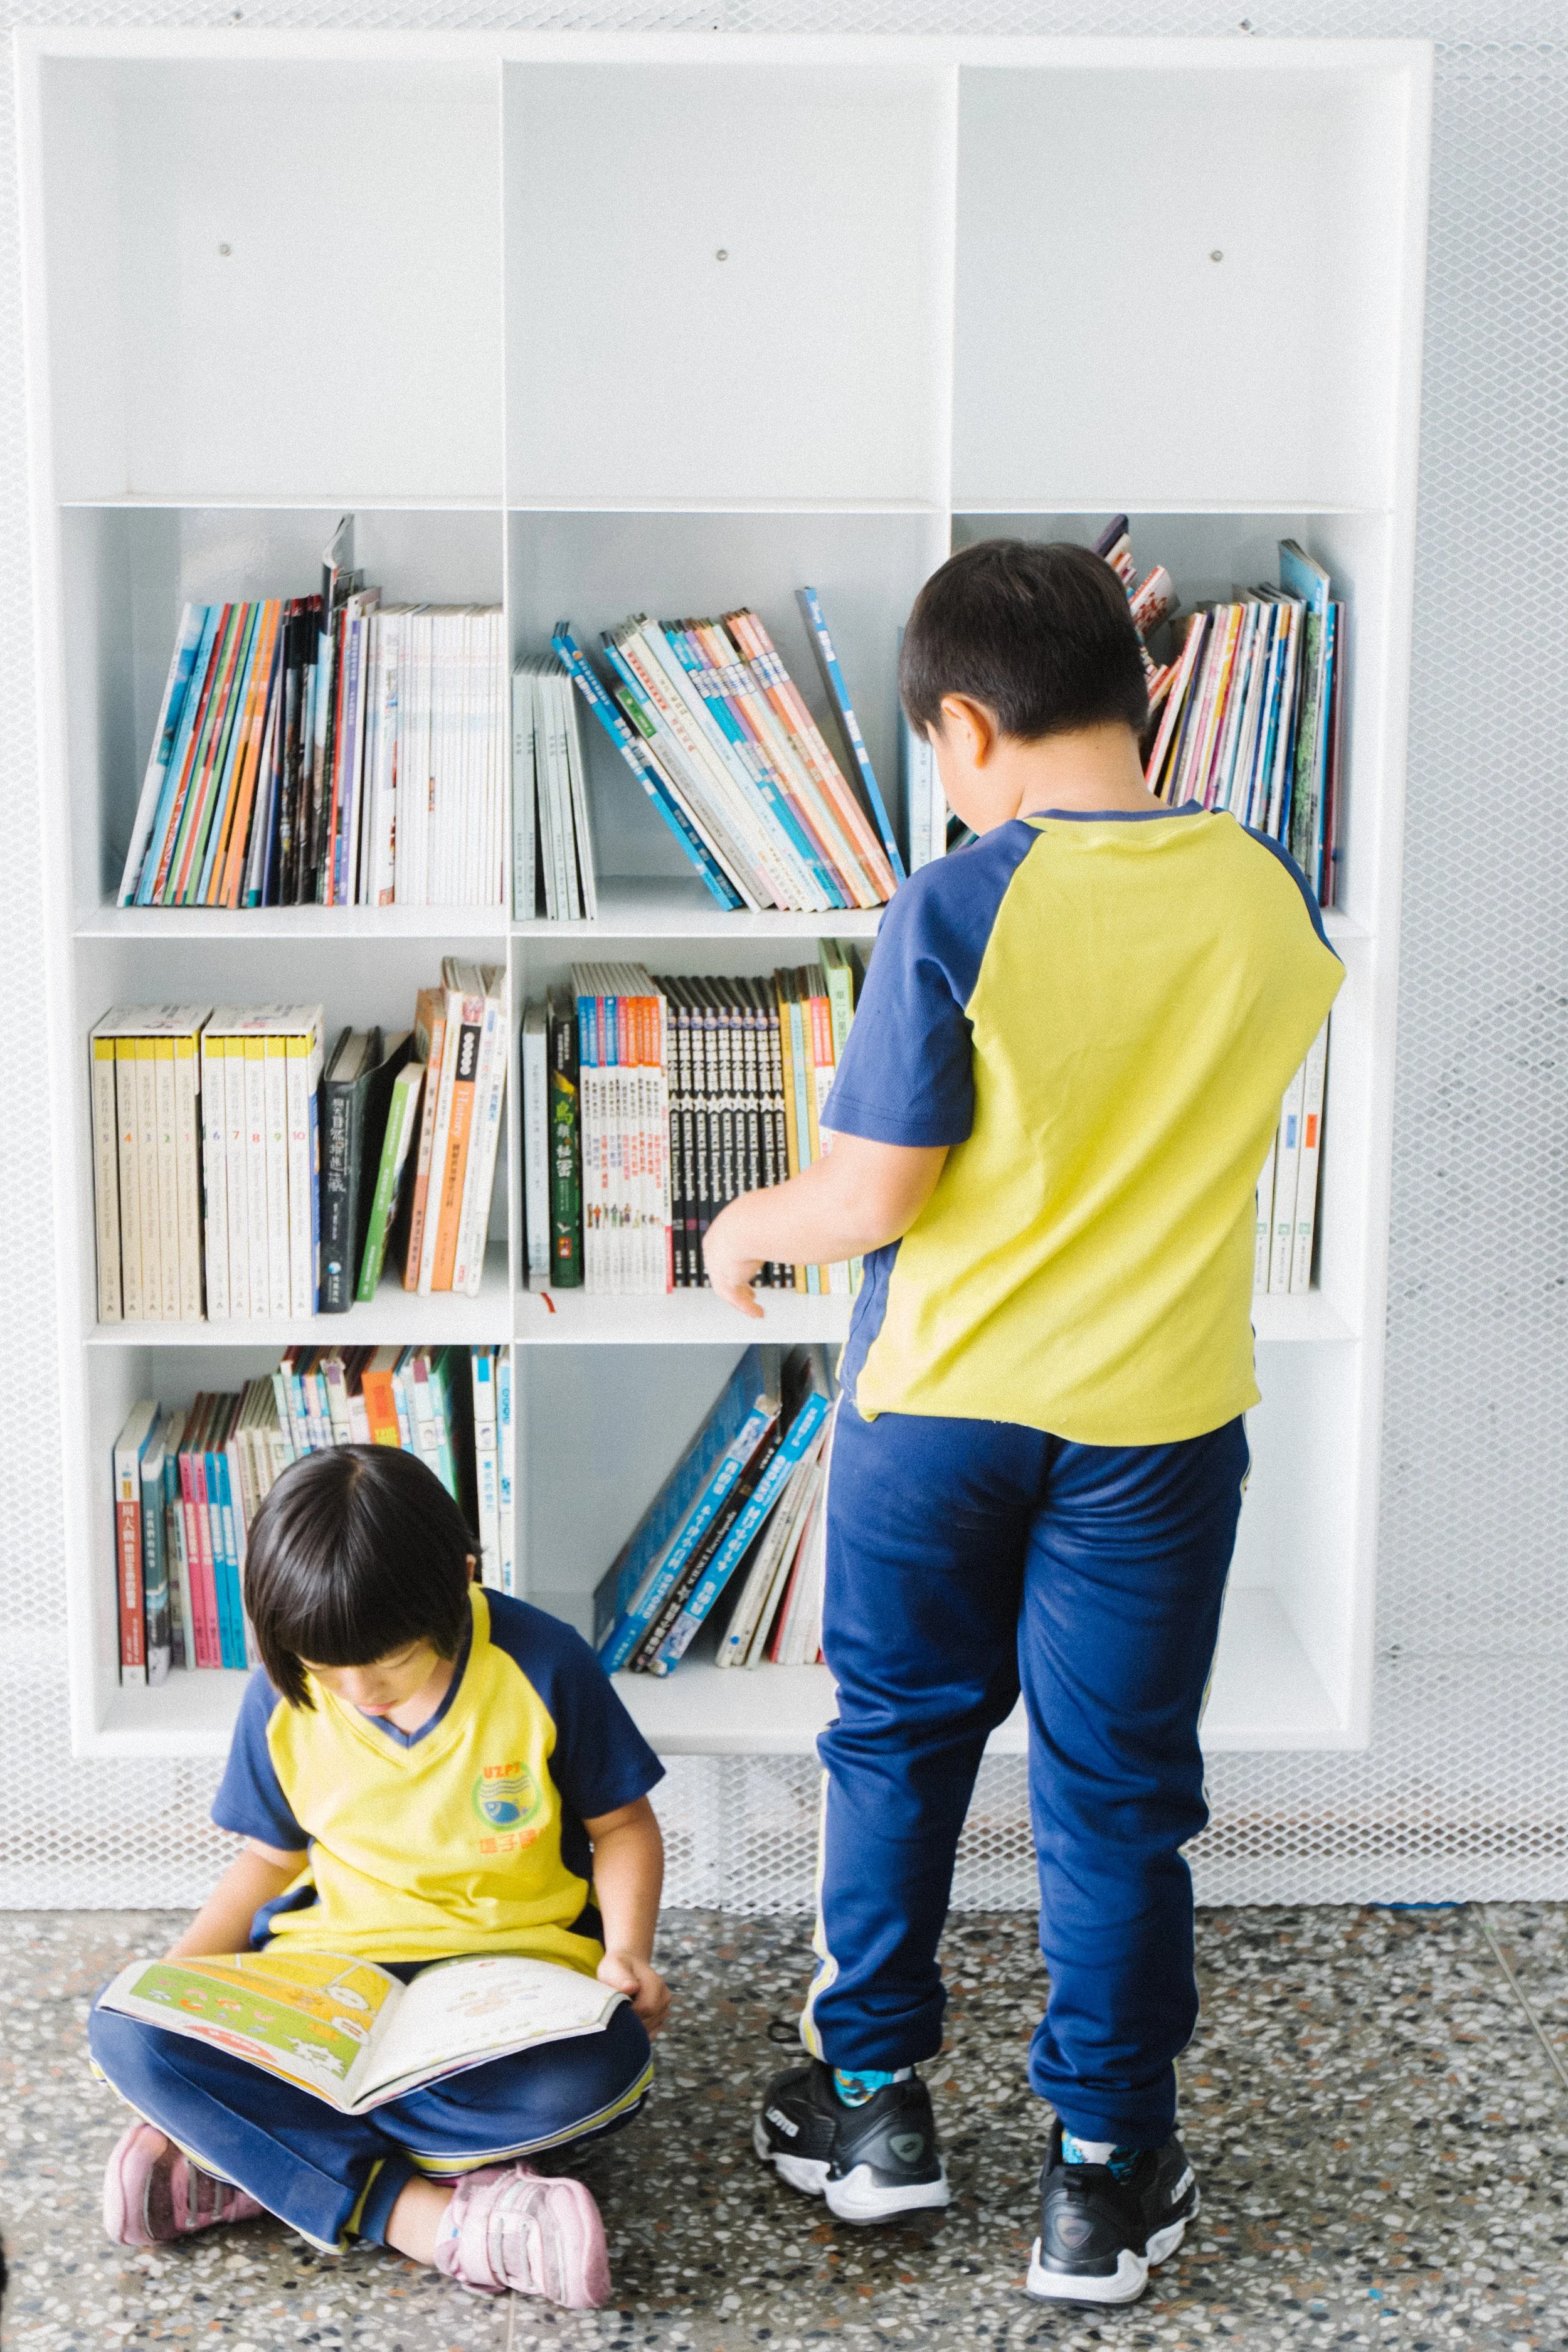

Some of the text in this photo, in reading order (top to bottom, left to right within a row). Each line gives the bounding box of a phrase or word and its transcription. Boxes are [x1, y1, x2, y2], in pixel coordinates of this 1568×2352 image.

[124, 1133, 132, 1142] 4
[164, 1134, 171, 1143] 2
[233, 1131, 240, 1139] 7
[253, 1133, 260, 1143] 8
[294, 1131, 305, 1140] 10
[753, 1455, 786, 1503] OXFORD
[642, 1576, 673, 1619] OXFORD
[765, 2106, 800, 2137] LOTTO
